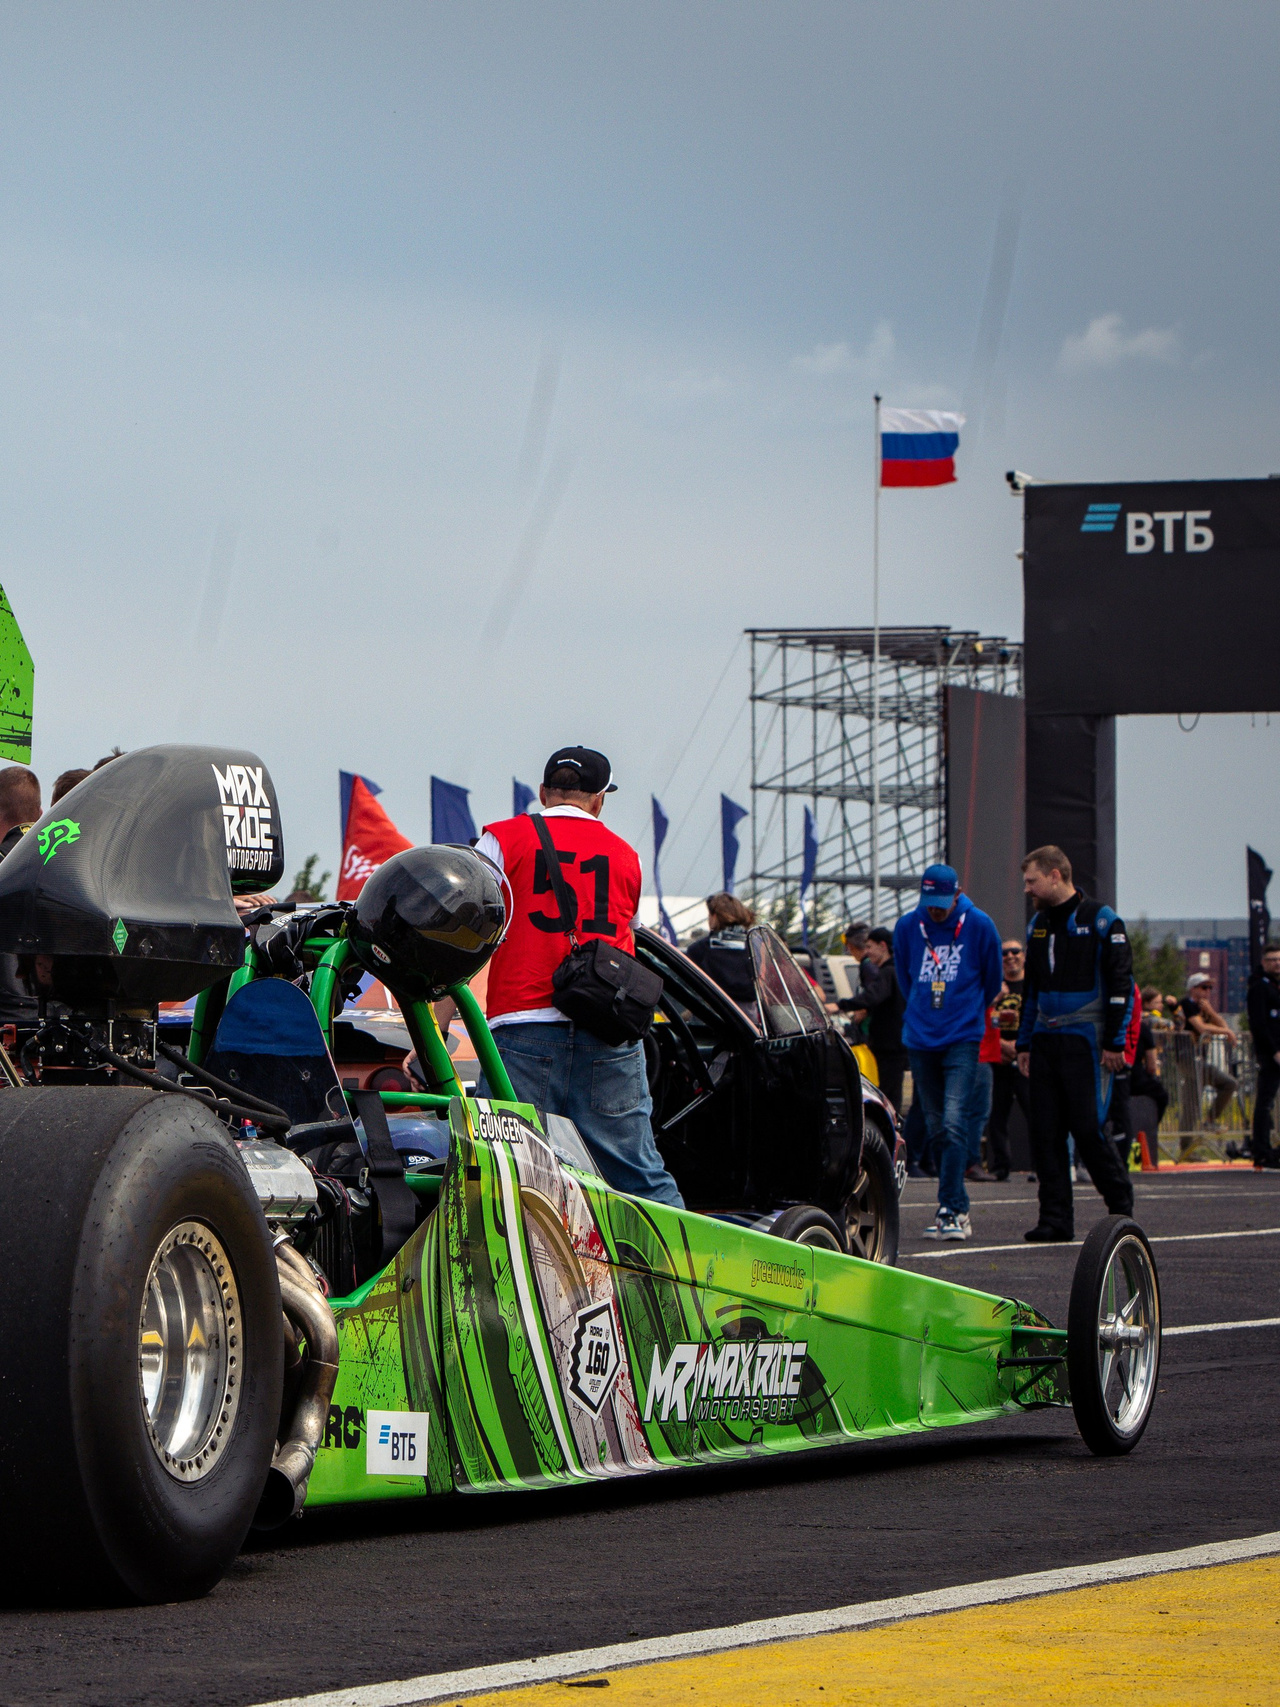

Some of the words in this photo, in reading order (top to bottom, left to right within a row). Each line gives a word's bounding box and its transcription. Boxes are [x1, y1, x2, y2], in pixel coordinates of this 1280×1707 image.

[1126, 510, 1215, 554] ВТБ
[211, 763, 270, 807] MAX
[222, 805, 273, 849] RIDE
[226, 848, 273, 871] MOTORSPORT
[528, 848, 618, 938] 51
[479, 1113, 524, 1144] GUNGER
[751, 1259, 806, 1290] greenworks
[585, 1340, 610, 1377] 160
[697, 1397, 798, 1421] MOTORSPORT
[391, 1432, 417, 1461] ВТБ
